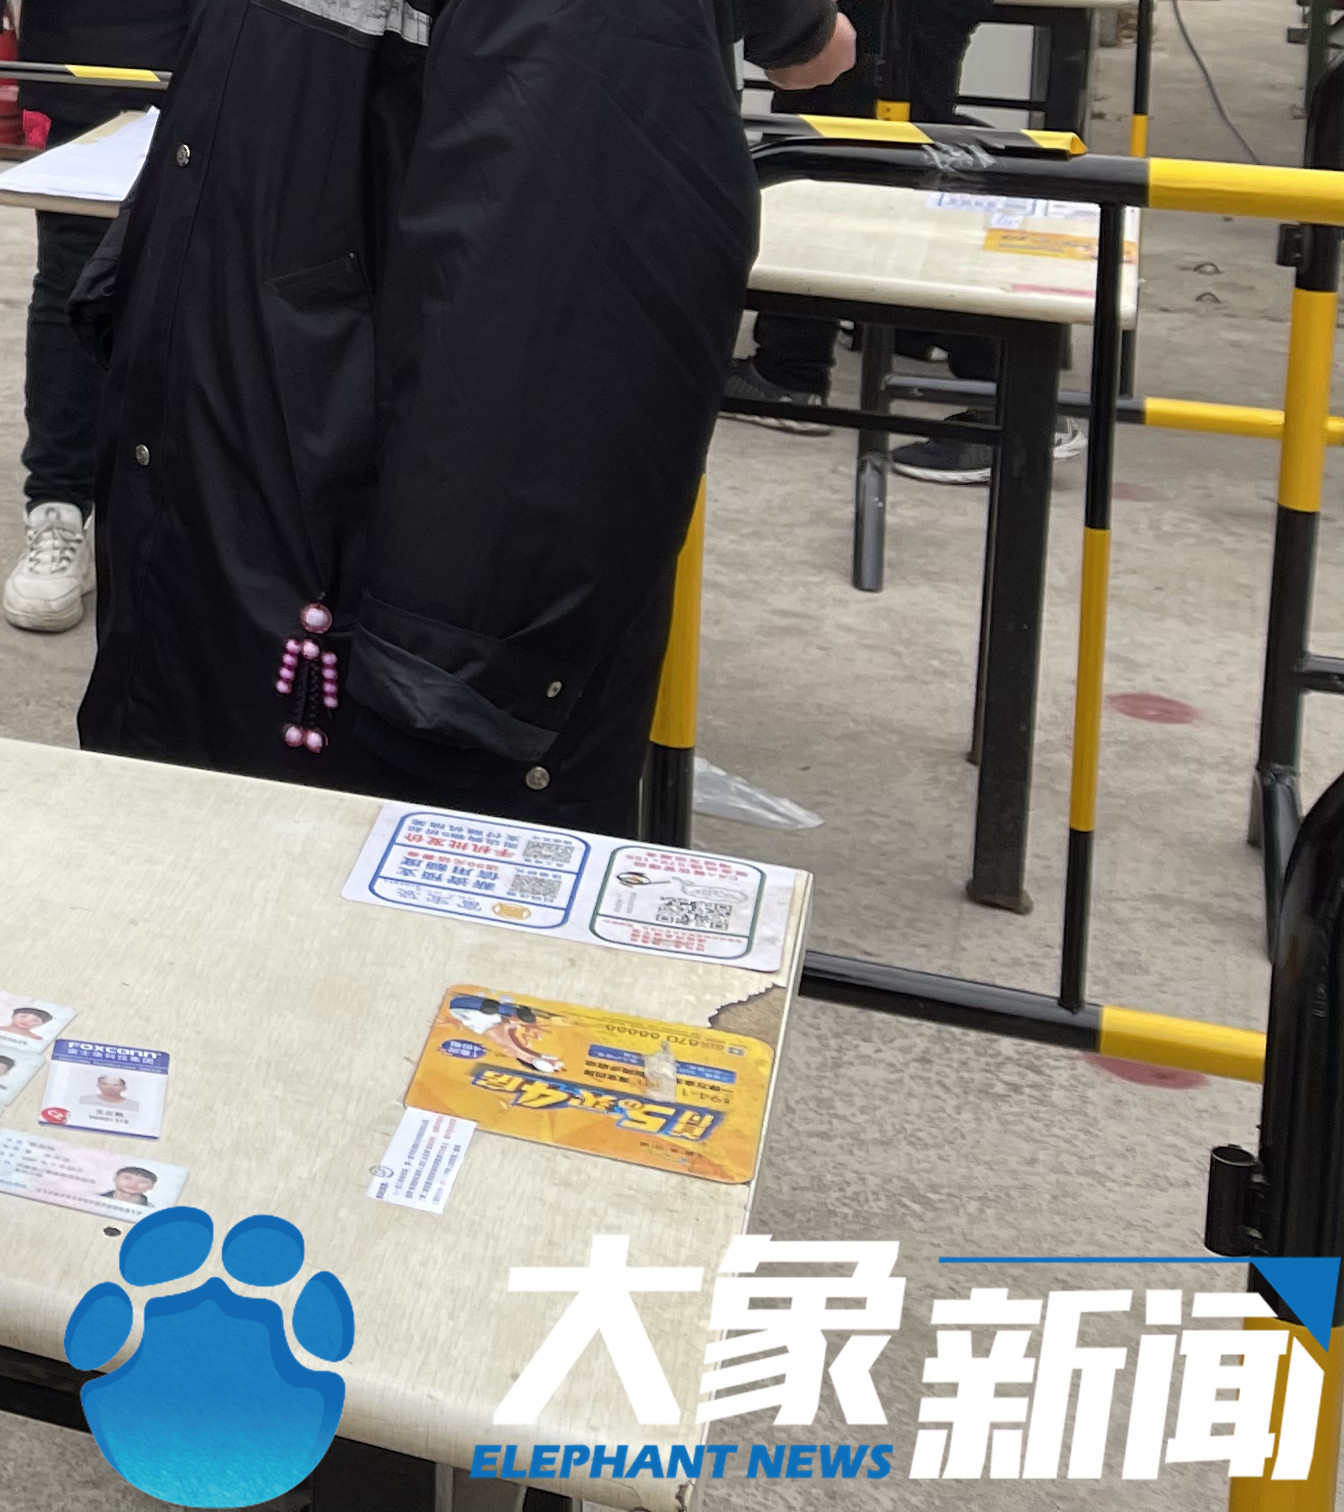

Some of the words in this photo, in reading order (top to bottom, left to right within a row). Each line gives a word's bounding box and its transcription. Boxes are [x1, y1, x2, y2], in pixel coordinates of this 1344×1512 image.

[403, 832, 515, 858] 手机批发价
